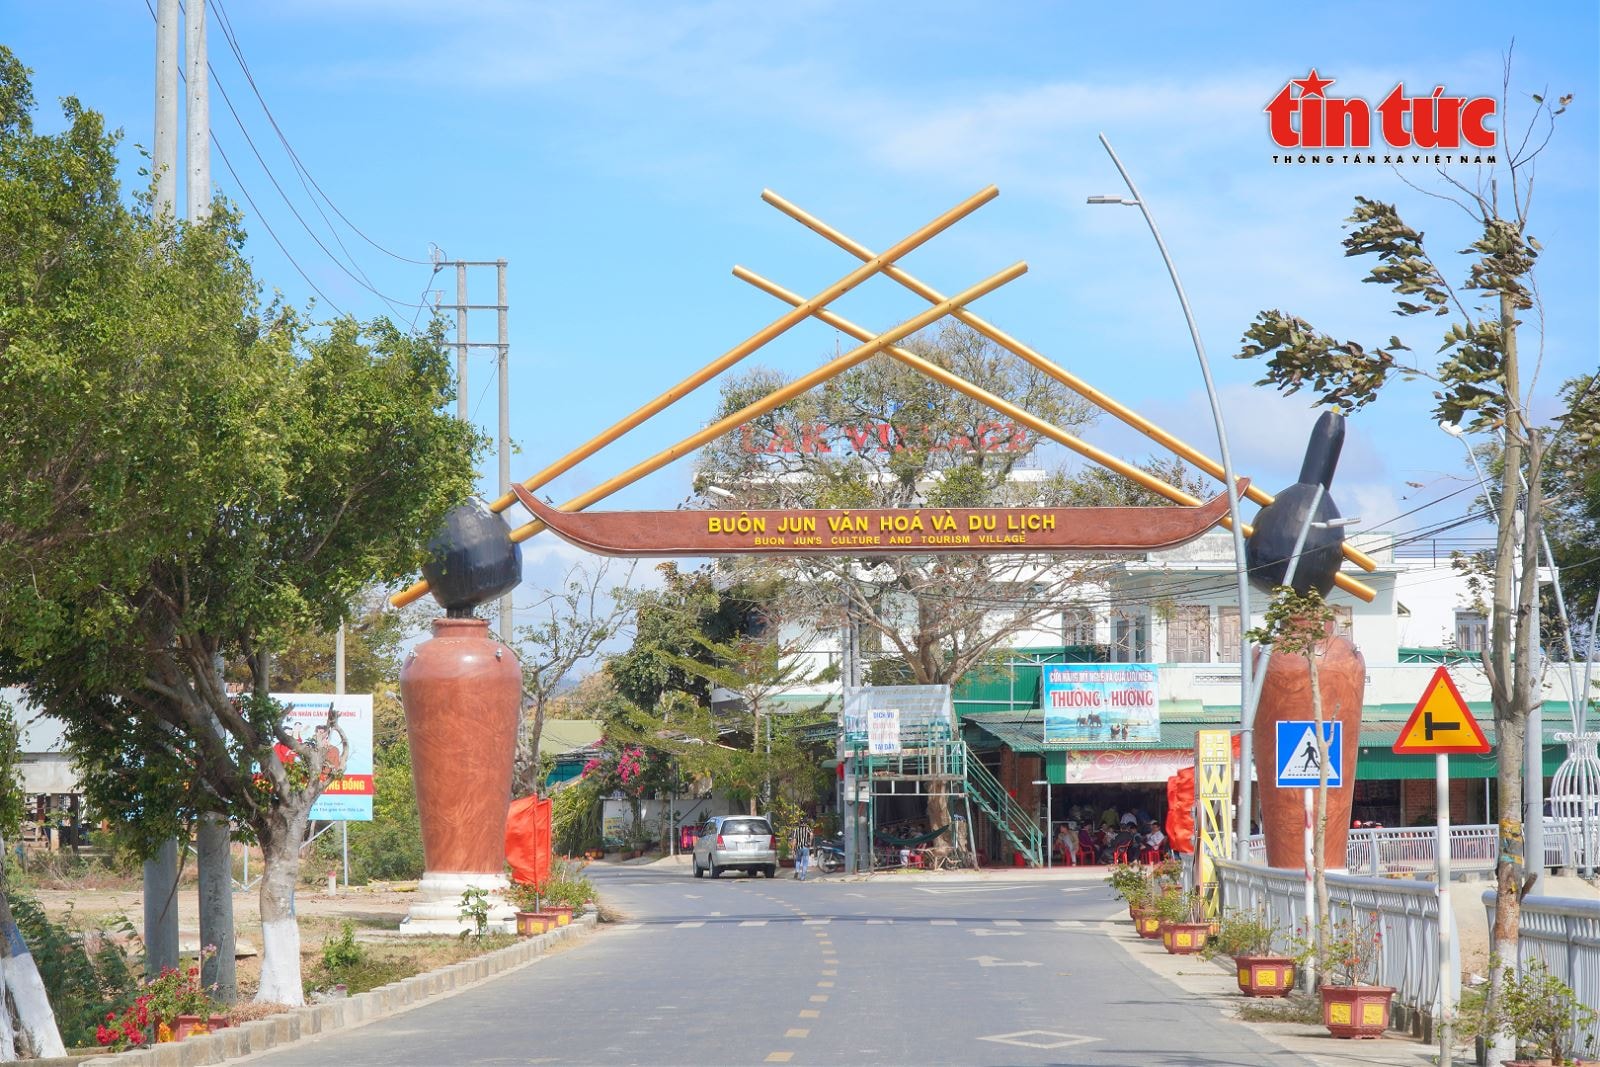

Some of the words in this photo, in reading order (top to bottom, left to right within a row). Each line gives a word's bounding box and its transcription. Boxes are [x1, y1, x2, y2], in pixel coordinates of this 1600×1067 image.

[708, 512, 766, 533] BUÔN
[777, 516, 816, 532] JUN
[828, 511, 869, 532] VĂN
[880, 510, 923, 531] HOÁ
[931, 510, 957, 531] VÀ
[969, 515, 997, 530] DU
[1007, 514, 1056, 534] LỊCH
[754, 537, 785, 545] BUON
[793, 536, 823, 545] JUN'S
[831, 536, 881, 544] CULTURE
[889, 535, 912, 544] AND
[921, 535, 970, 544] TOURISM
[978, 534, 1026, 543] VILLAGE
